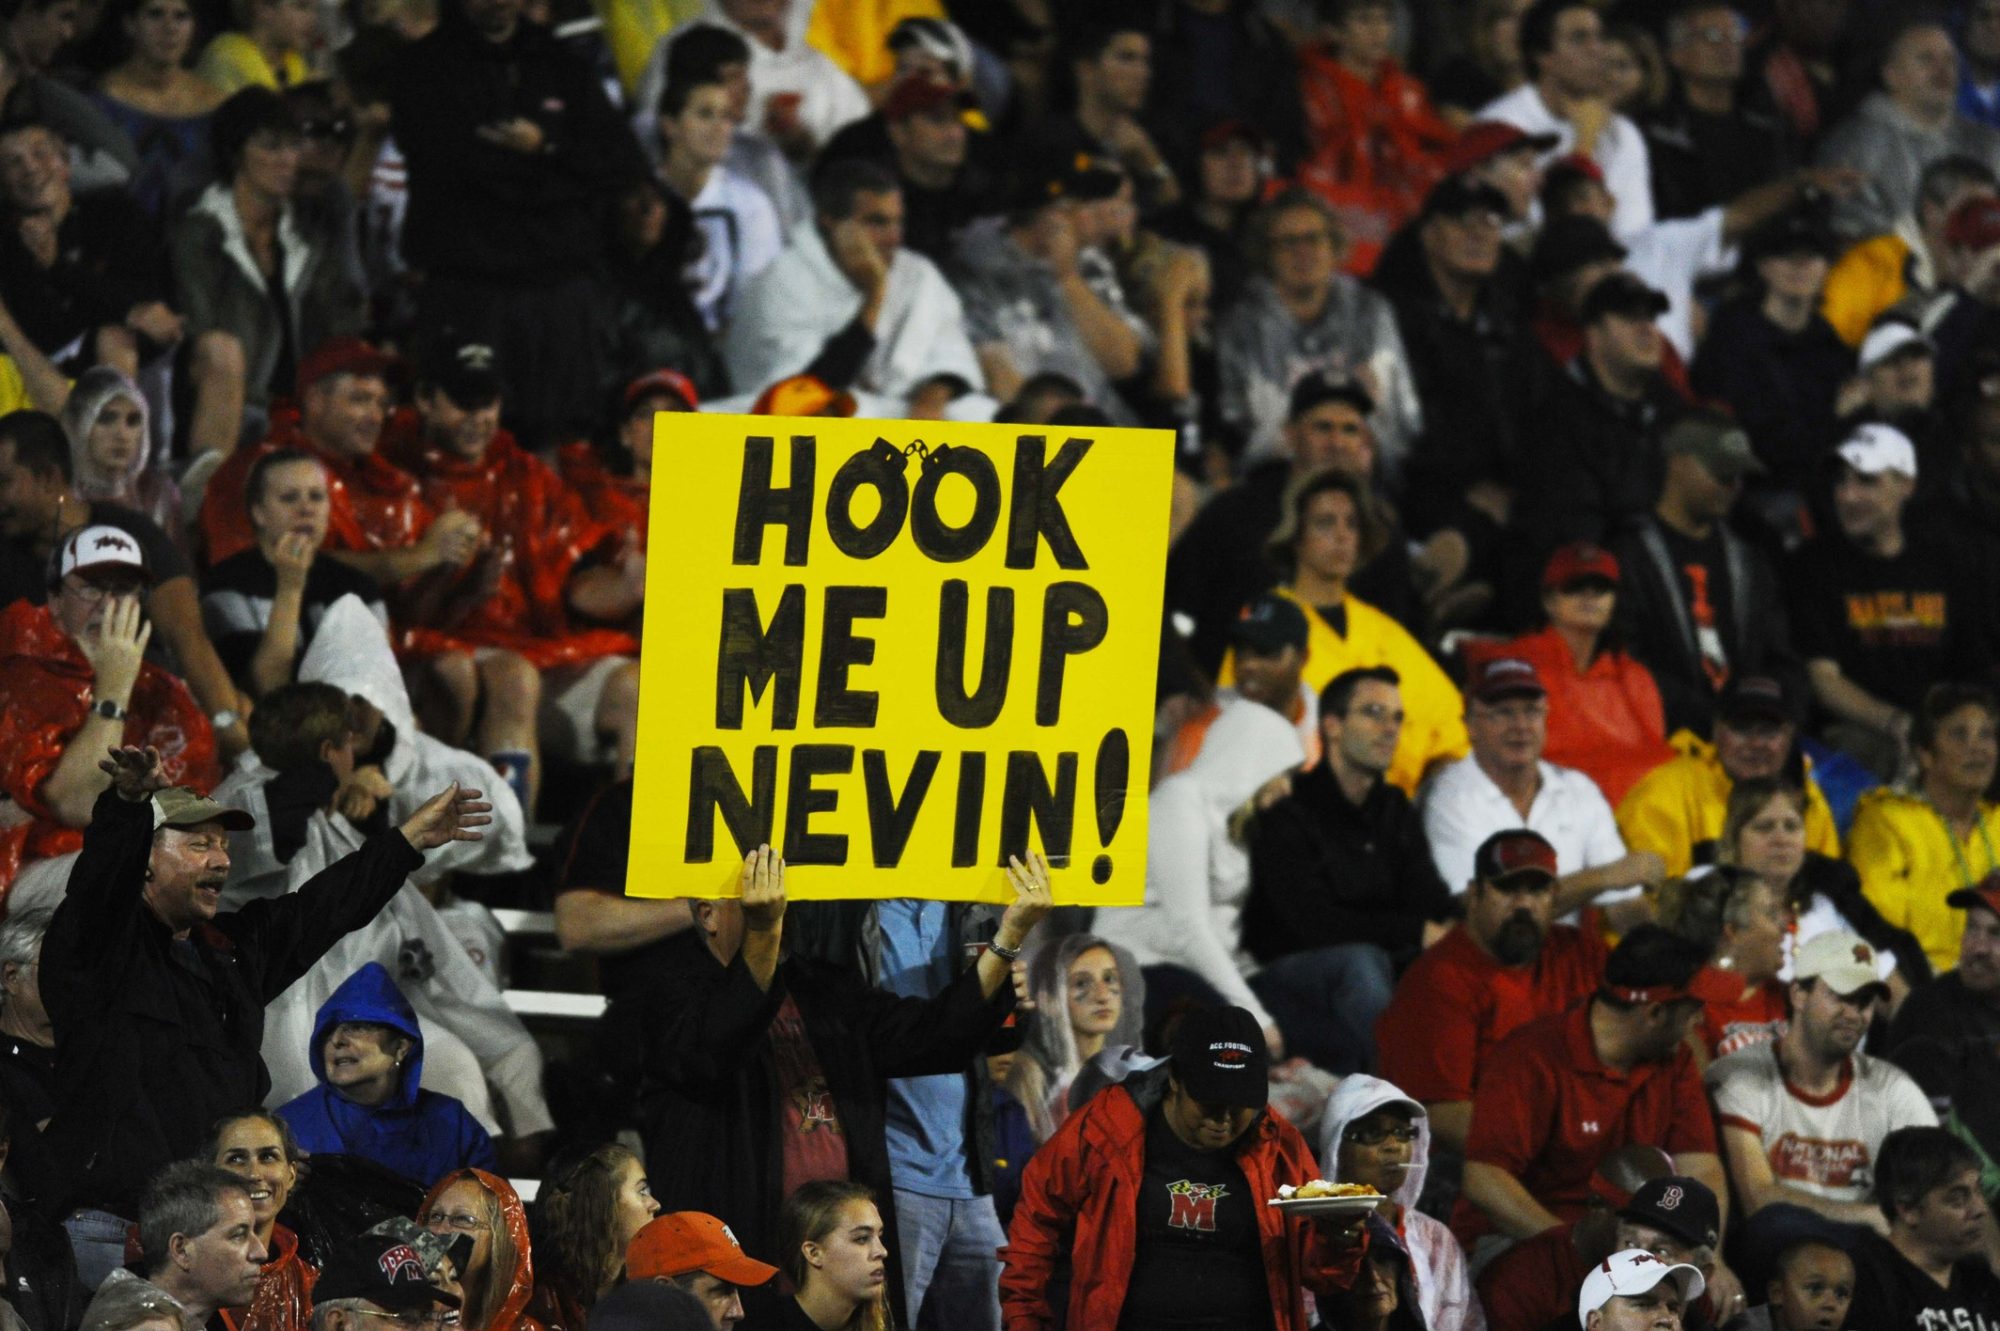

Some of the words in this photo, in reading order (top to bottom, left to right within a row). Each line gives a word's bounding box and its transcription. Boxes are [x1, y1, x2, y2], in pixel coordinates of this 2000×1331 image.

[733, 435, 1094, 571] HOOK
[715, 583, 888, 731] ME
[935, 578, 1109, 729] UP
[684, 727, 1130, 887] NEVIN!
[1168, 1191, 1217, 1232] M
[1656, 1184, 1684, 1210] B
